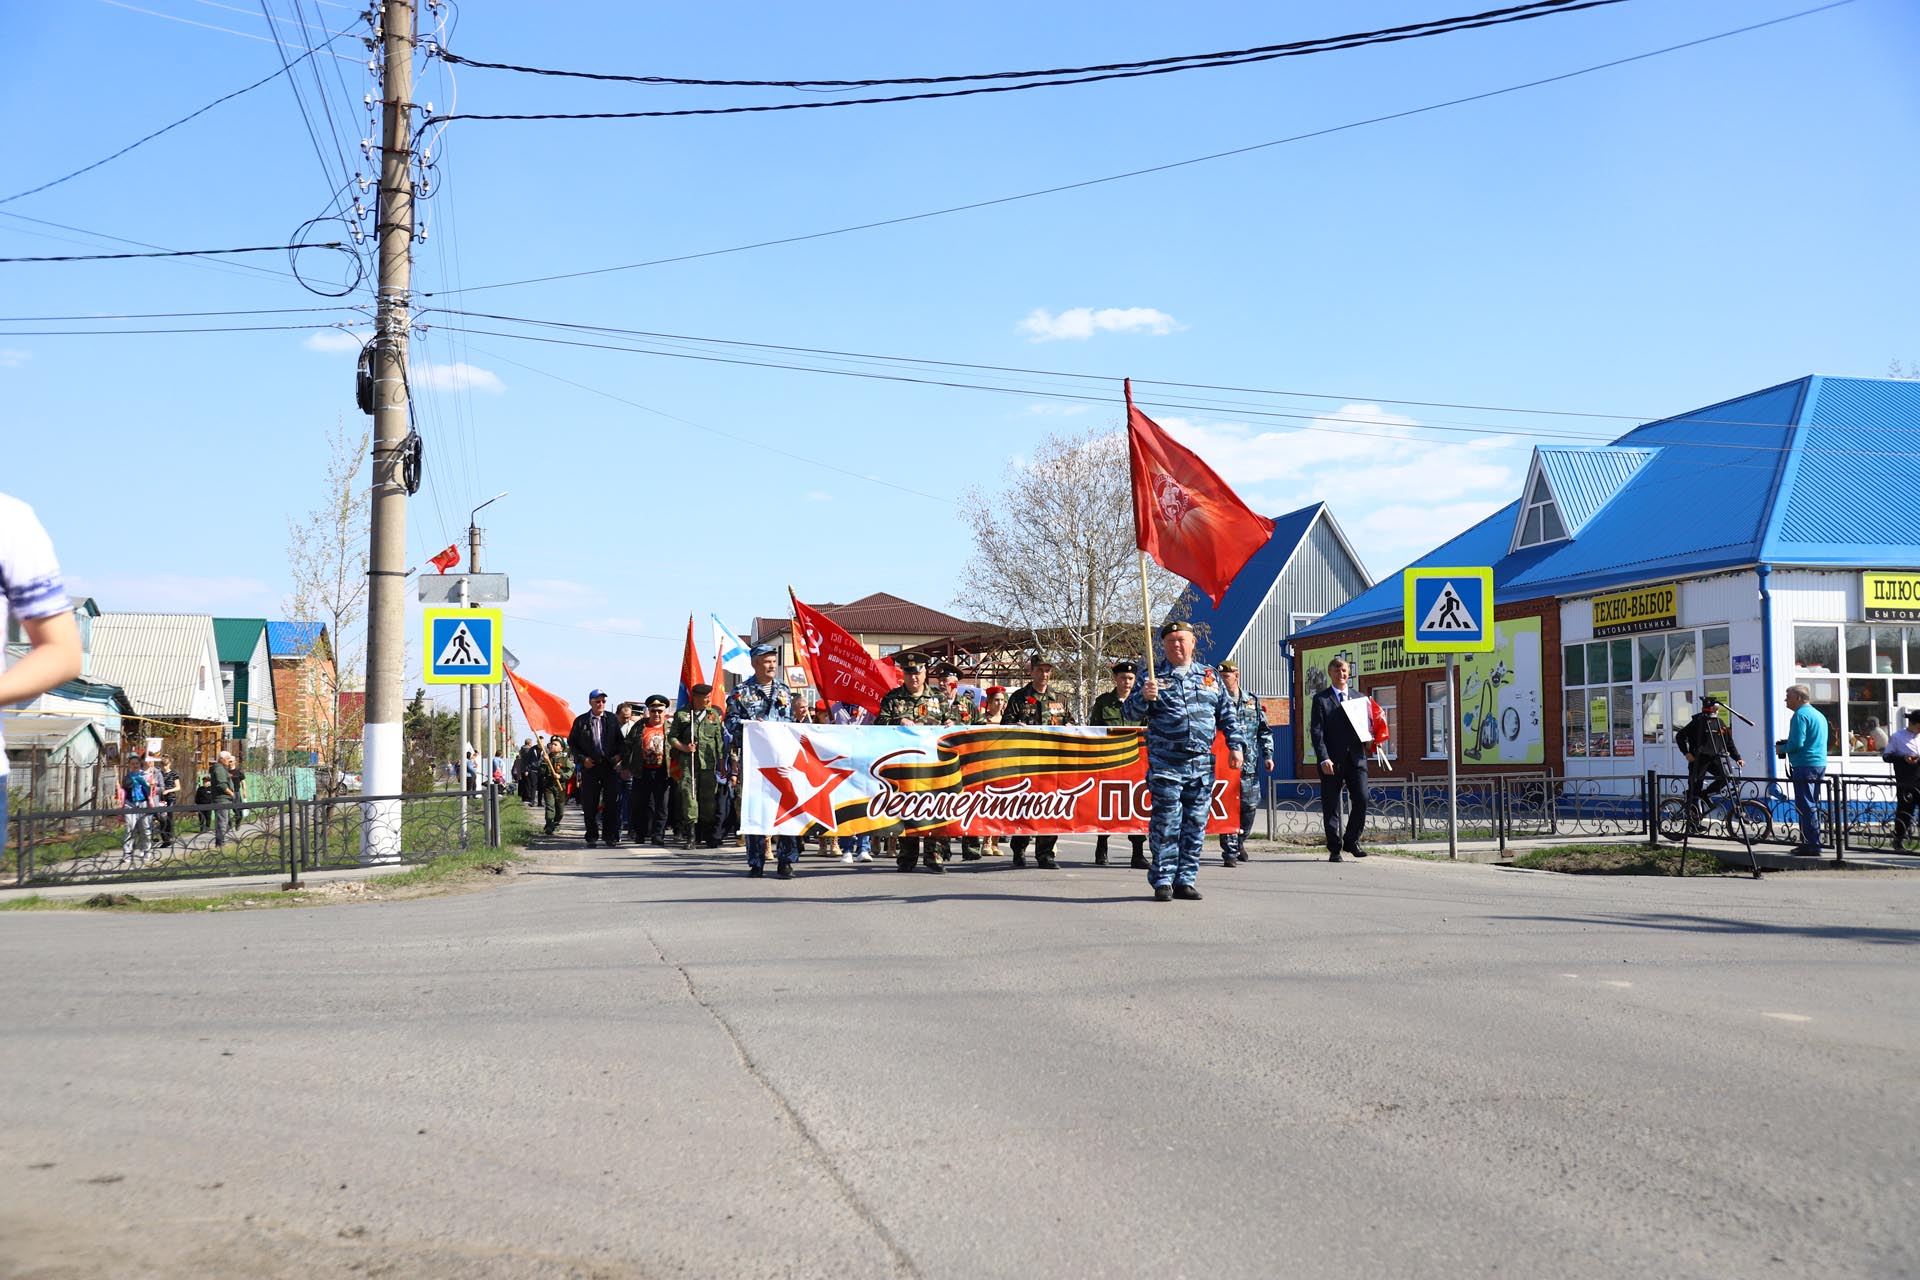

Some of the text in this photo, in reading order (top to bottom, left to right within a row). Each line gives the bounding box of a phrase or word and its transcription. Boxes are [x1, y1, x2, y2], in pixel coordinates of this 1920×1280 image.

[1874, 580, 1920, 601] ПЛЮС
[1594, 591, 1673, 623] ТЕХНО-ВЫБОР
[1597, 619, 1671, 636] БЫТОВАЯ ТЕХНИКА
[830, 632, 843, 644] 150
[1752, 657, 1759, 670] 48
[834, 669, 852, 687] 79
[1100, 781, 1228, 819] ПОК
